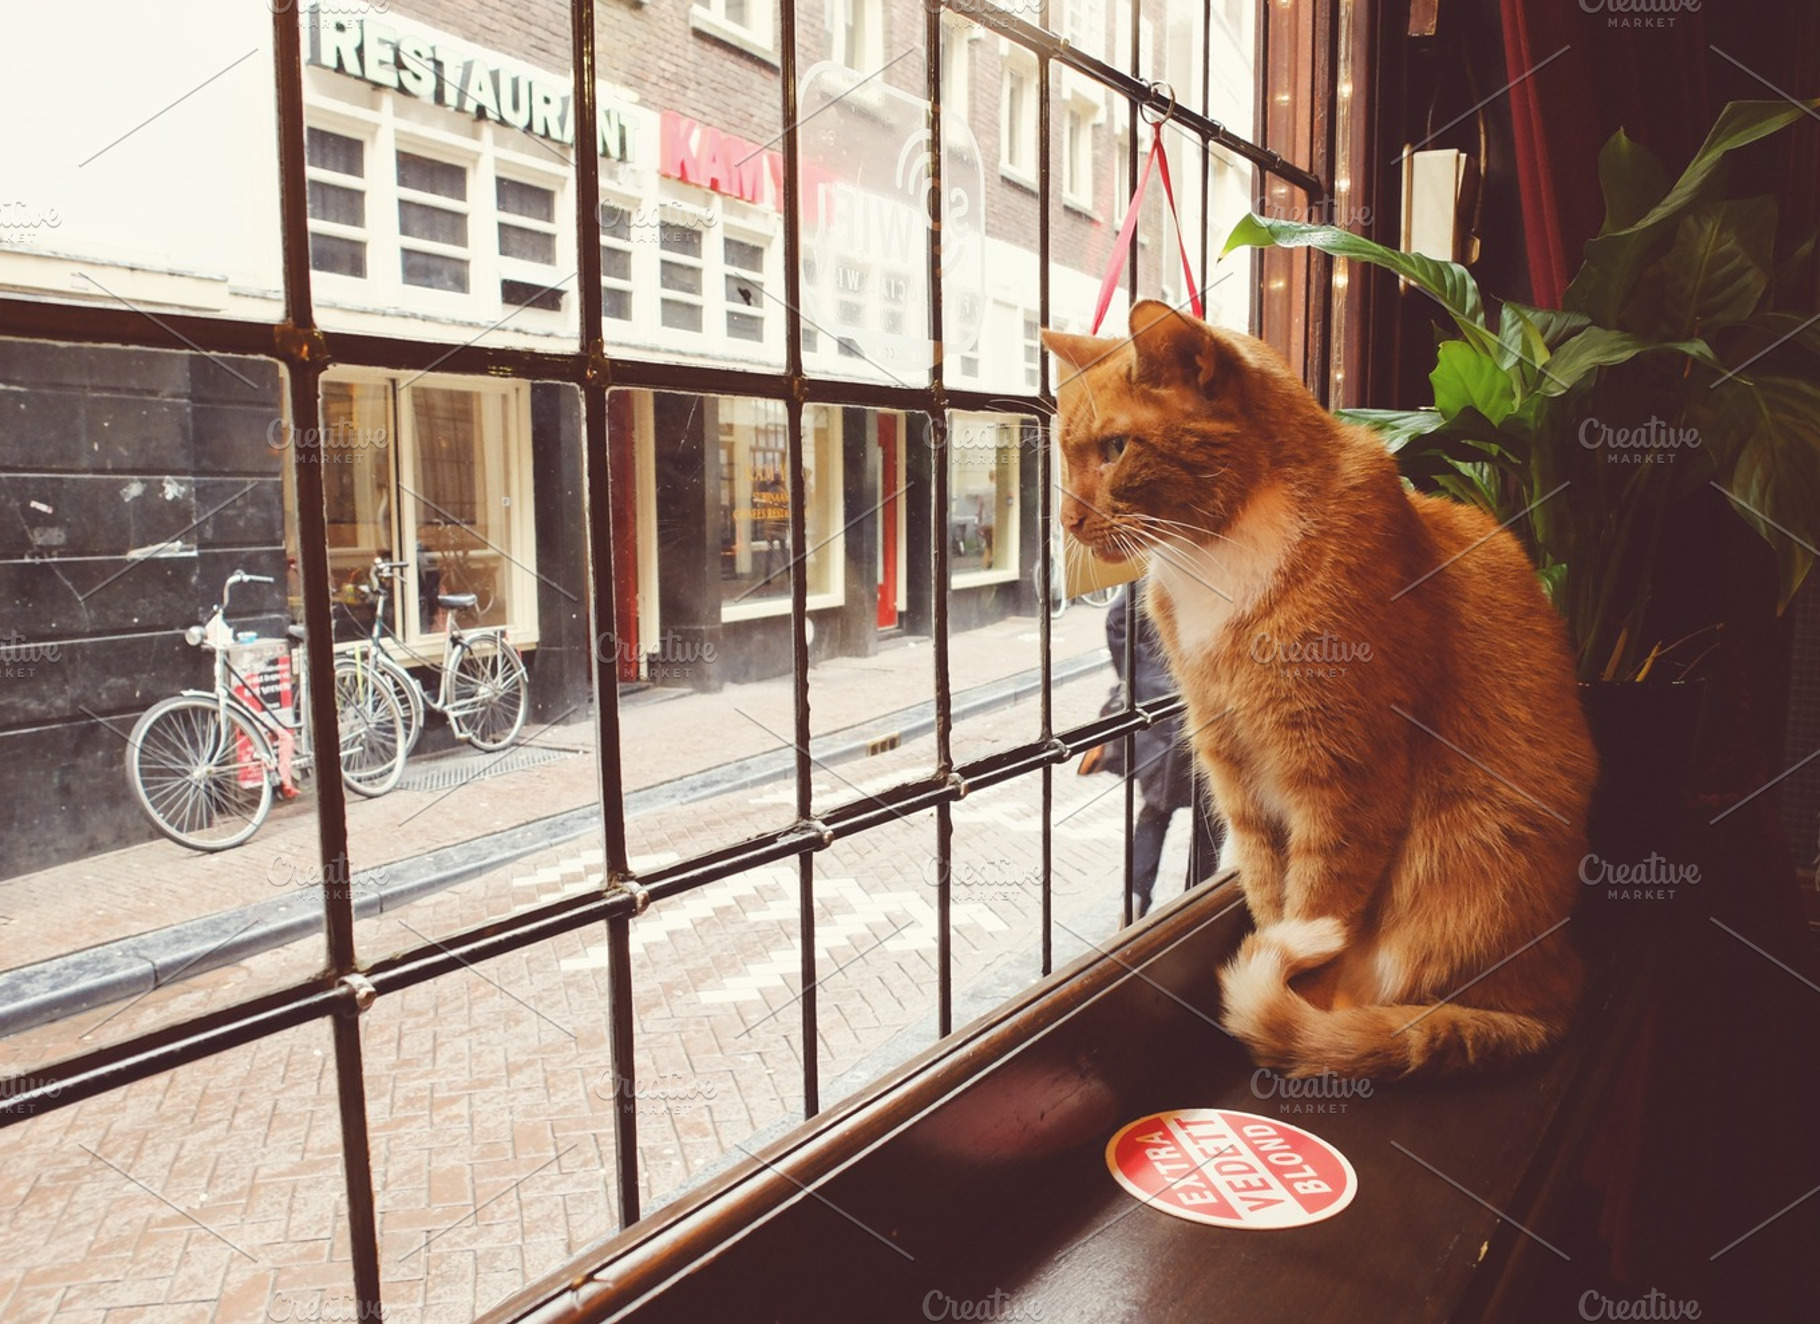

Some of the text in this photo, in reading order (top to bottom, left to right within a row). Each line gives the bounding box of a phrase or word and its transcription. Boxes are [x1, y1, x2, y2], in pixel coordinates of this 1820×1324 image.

[1135, 1130, 1218, 1206] EXTRA
[1173, 1116, 1286, 1213] VEDETT
[1242, 1124, 1333, 1196] BLOND
